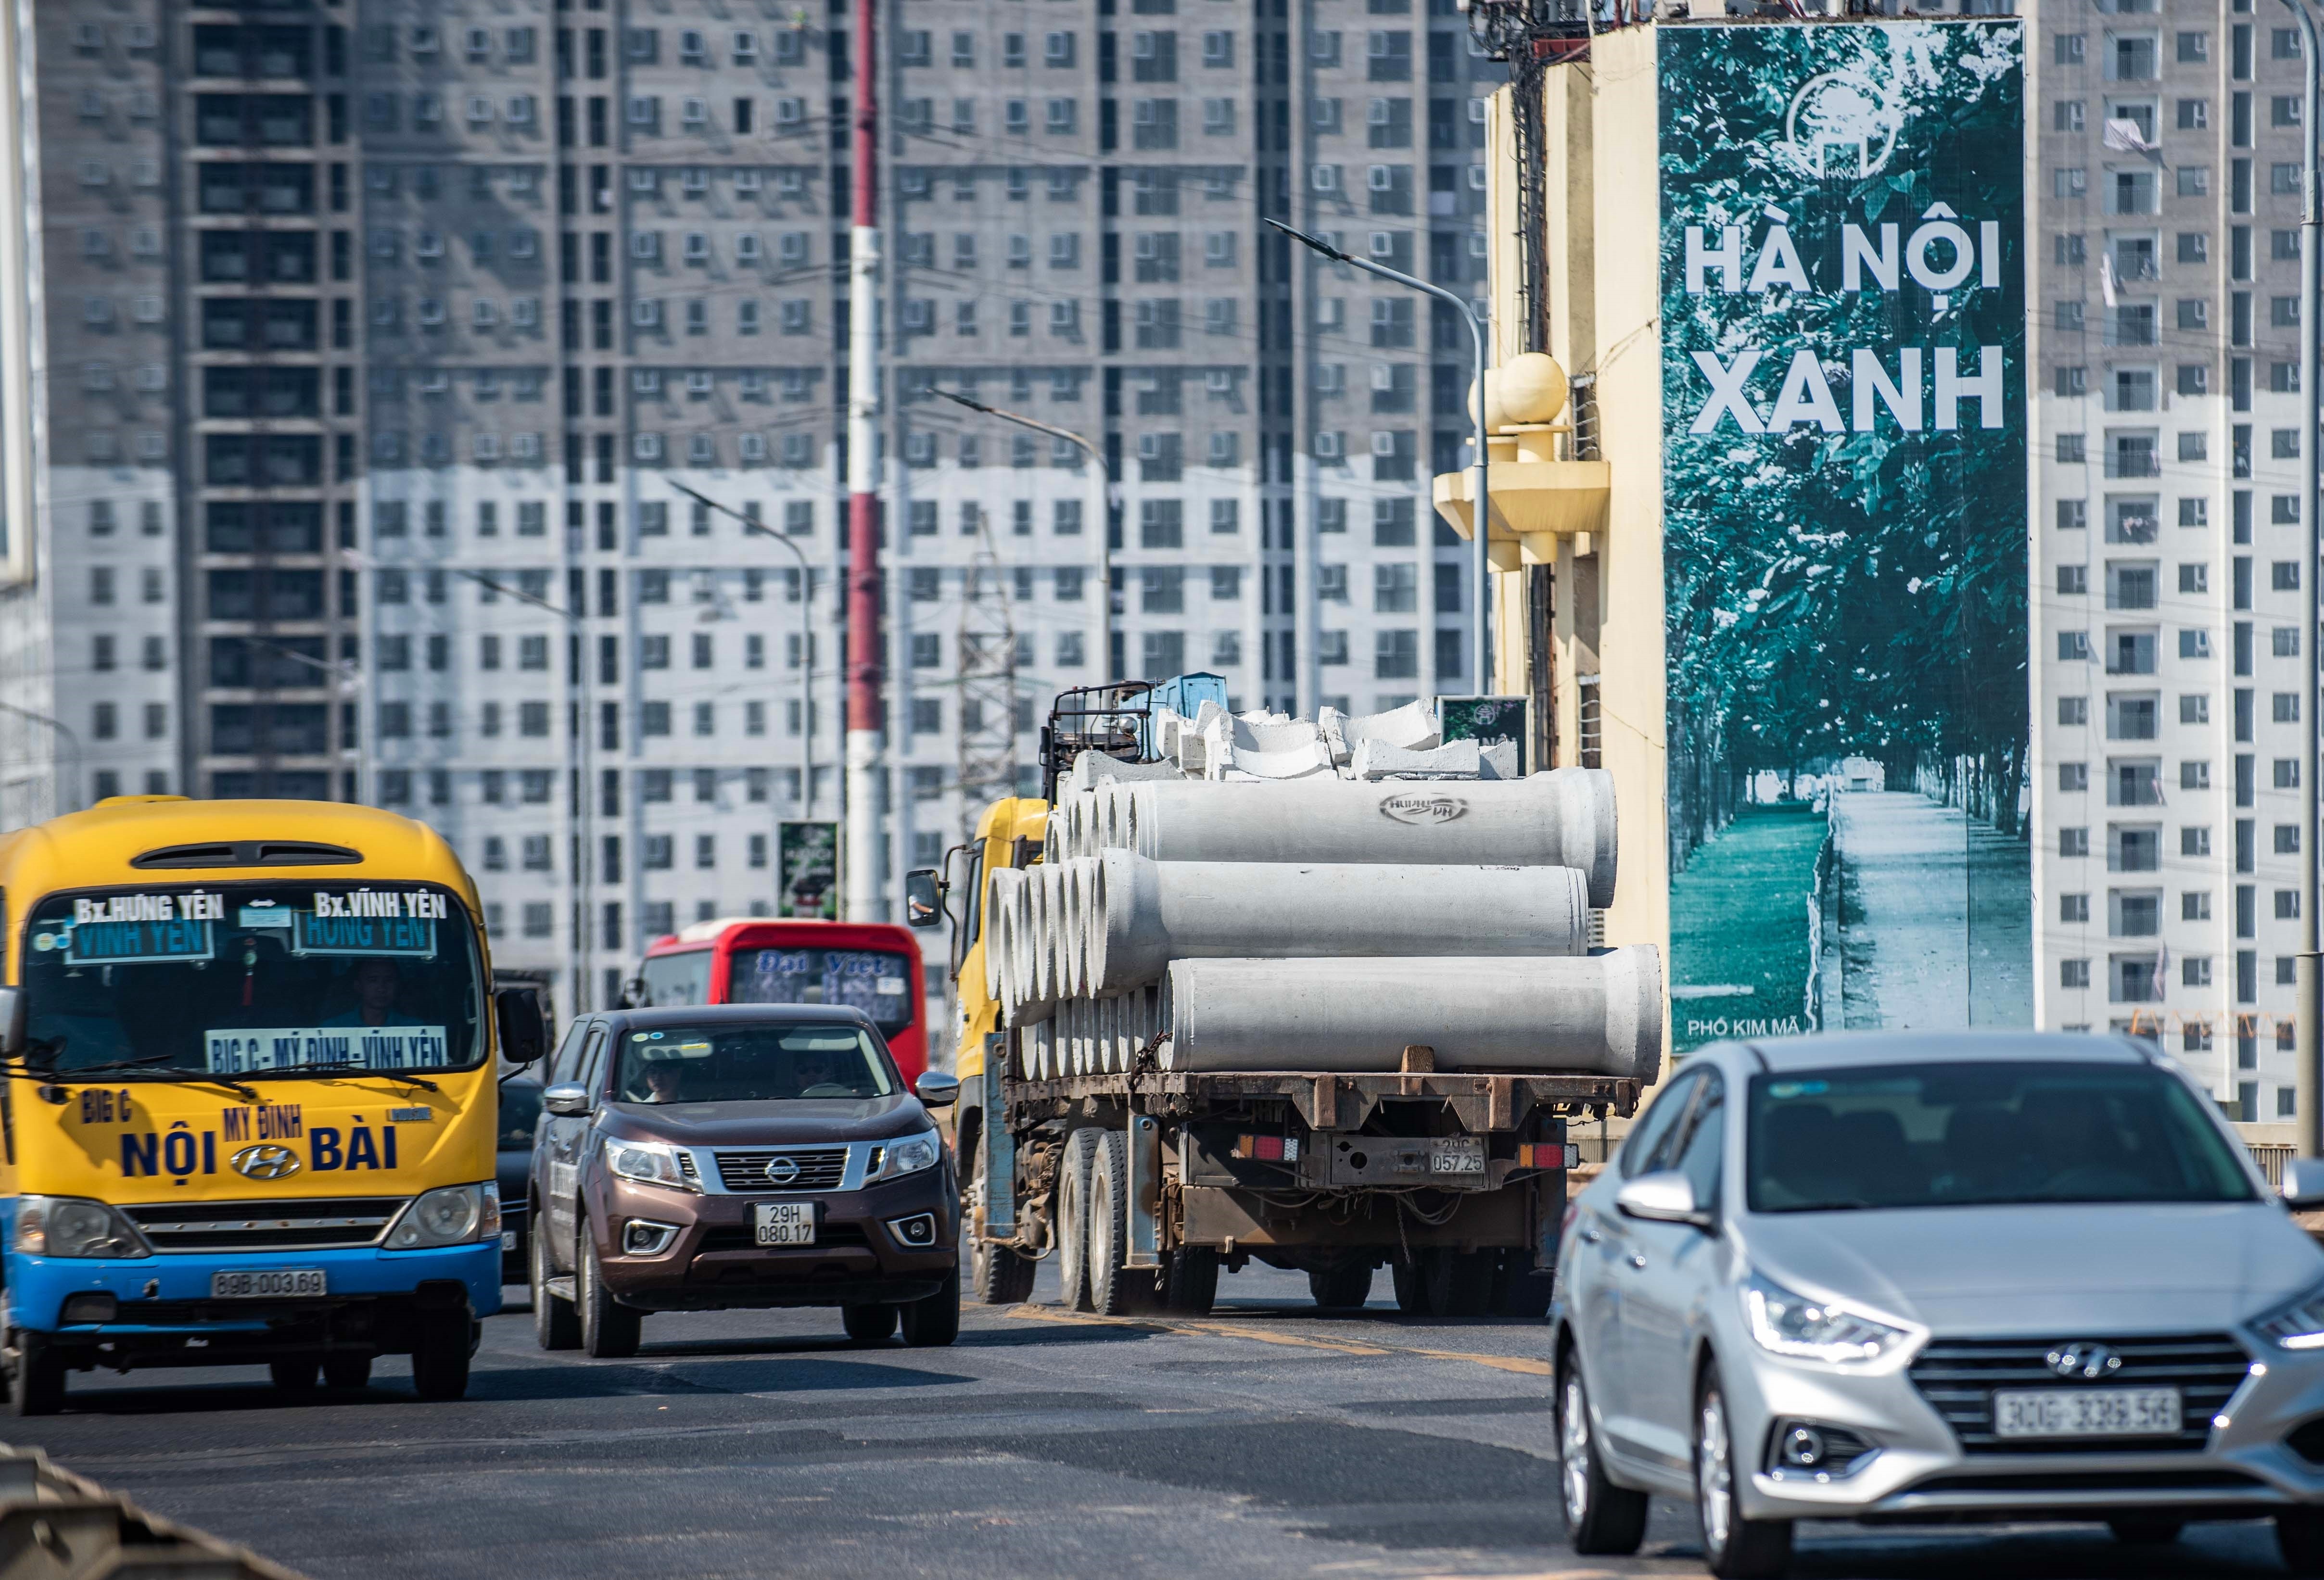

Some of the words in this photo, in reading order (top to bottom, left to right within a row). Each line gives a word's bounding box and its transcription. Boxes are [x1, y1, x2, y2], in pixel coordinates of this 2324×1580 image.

[1685, 202, 1812, 293] HÀ
[1842, 202, 2000, 311] NỘI
[1687, 345, 2003, 434] XANH
[178, 889, 224, 920] YÊN
[314, 888, 400, 917] Bx.VĨNH
[403, 888, 447, 919] YÊN
[1734, 1019, 1766, 1036] KIM
[1772, 1015, 1800, 1035] MÃ
[212, 1038, 241, 1073] BIG
[247, 1038, 260, 1071] C
[362, 1029, 403, 1069] VĨNH
[408, 1028, 443, 1067] YÊN
[121, 1121, 216, 1186] NỘI
[309, 1114, 397, 1171] BÀI
[1433, 1155, 1482, 1171] 057.25
[770, 1205, 800, 1223] 29H
[759, 1224, 812, 1242] 080.17
